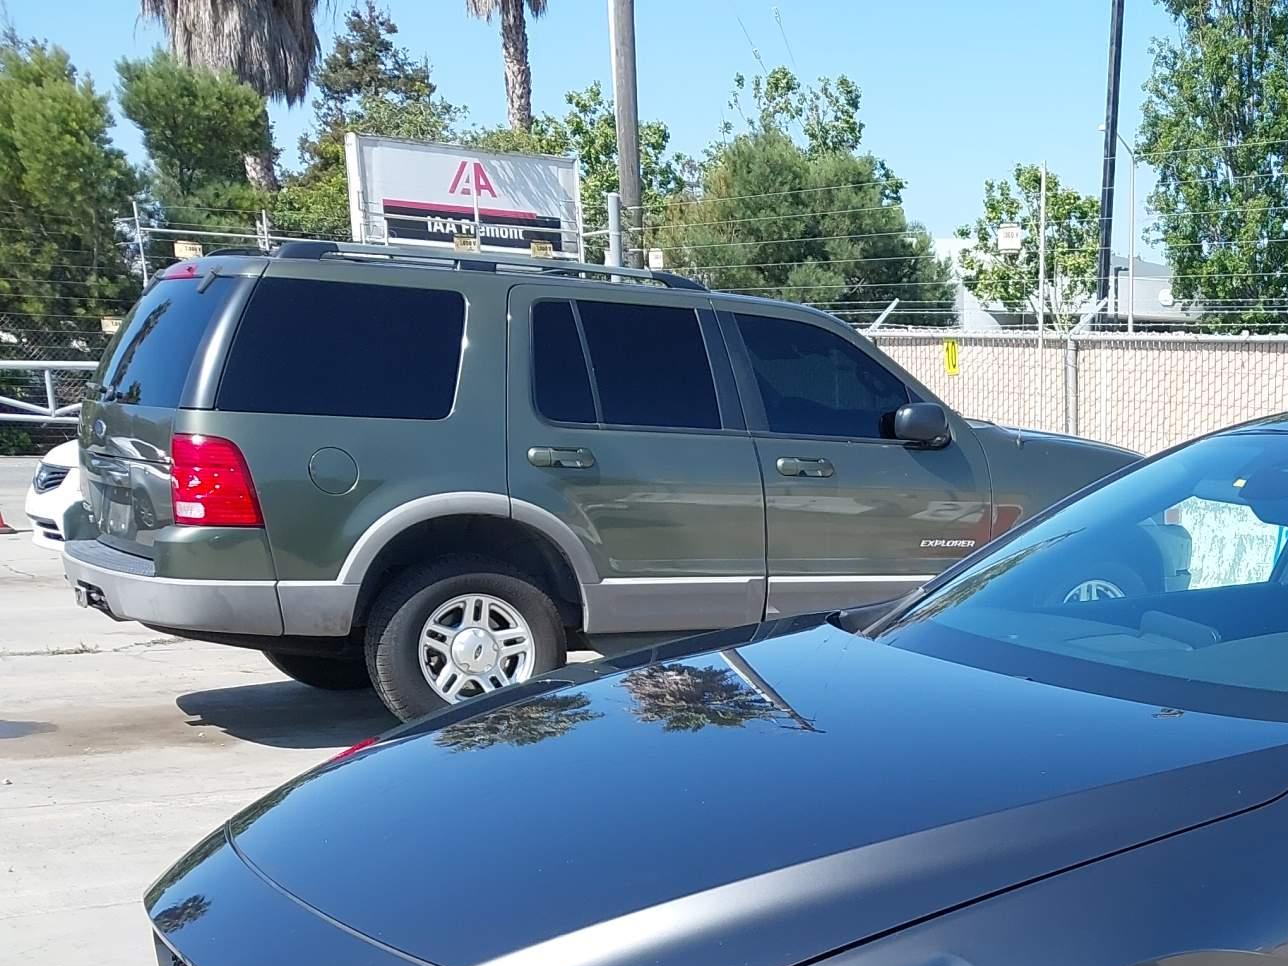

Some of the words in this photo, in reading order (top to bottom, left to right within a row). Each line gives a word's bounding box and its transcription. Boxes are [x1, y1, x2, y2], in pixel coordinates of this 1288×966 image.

[426, 215, 458, 233] IAA
[945, 341, 957, 369] 10
[920, 539, 976, 547] EXPLORER
